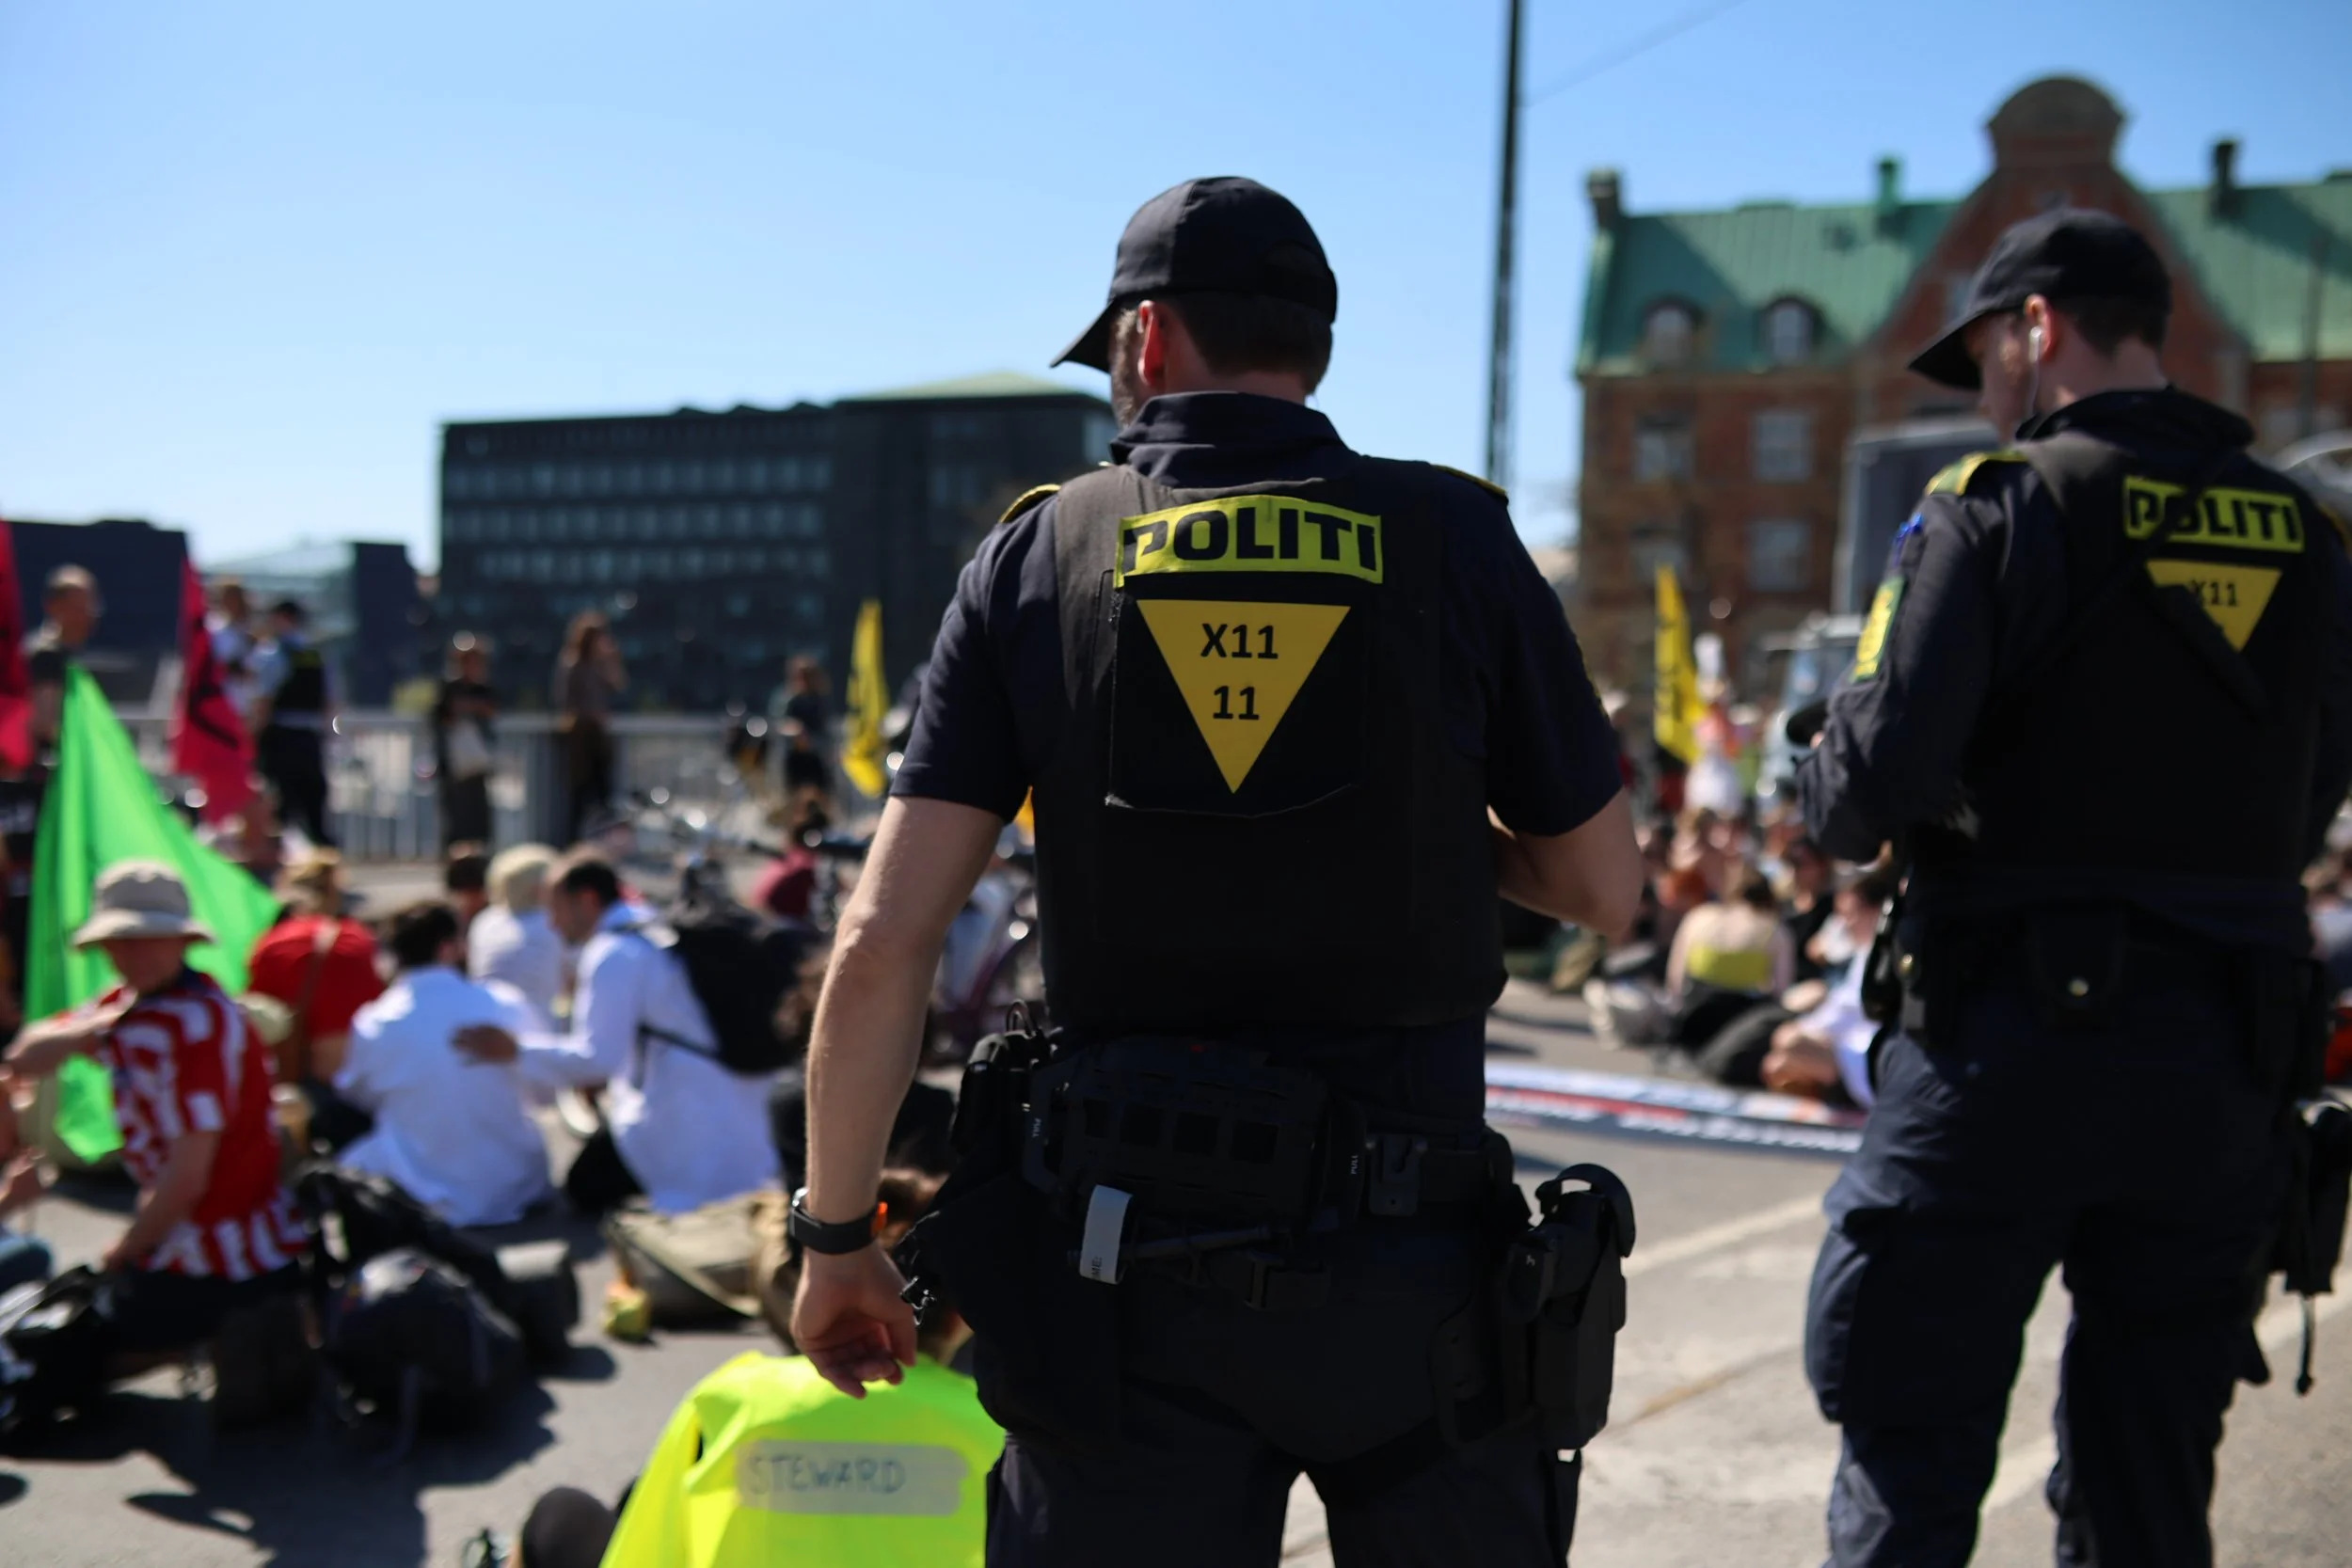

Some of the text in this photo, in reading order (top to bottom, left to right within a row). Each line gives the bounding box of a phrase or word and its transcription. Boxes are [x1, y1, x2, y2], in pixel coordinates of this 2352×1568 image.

[1122, 507, 1377, 573] POLITI
[1200, 623, 1279, 659] X11
[1212, 685, 1260, 721] 11
[1350, 1154, 1359, 1175] PULL
[748, 1452, 906, 1495] STEWARD
